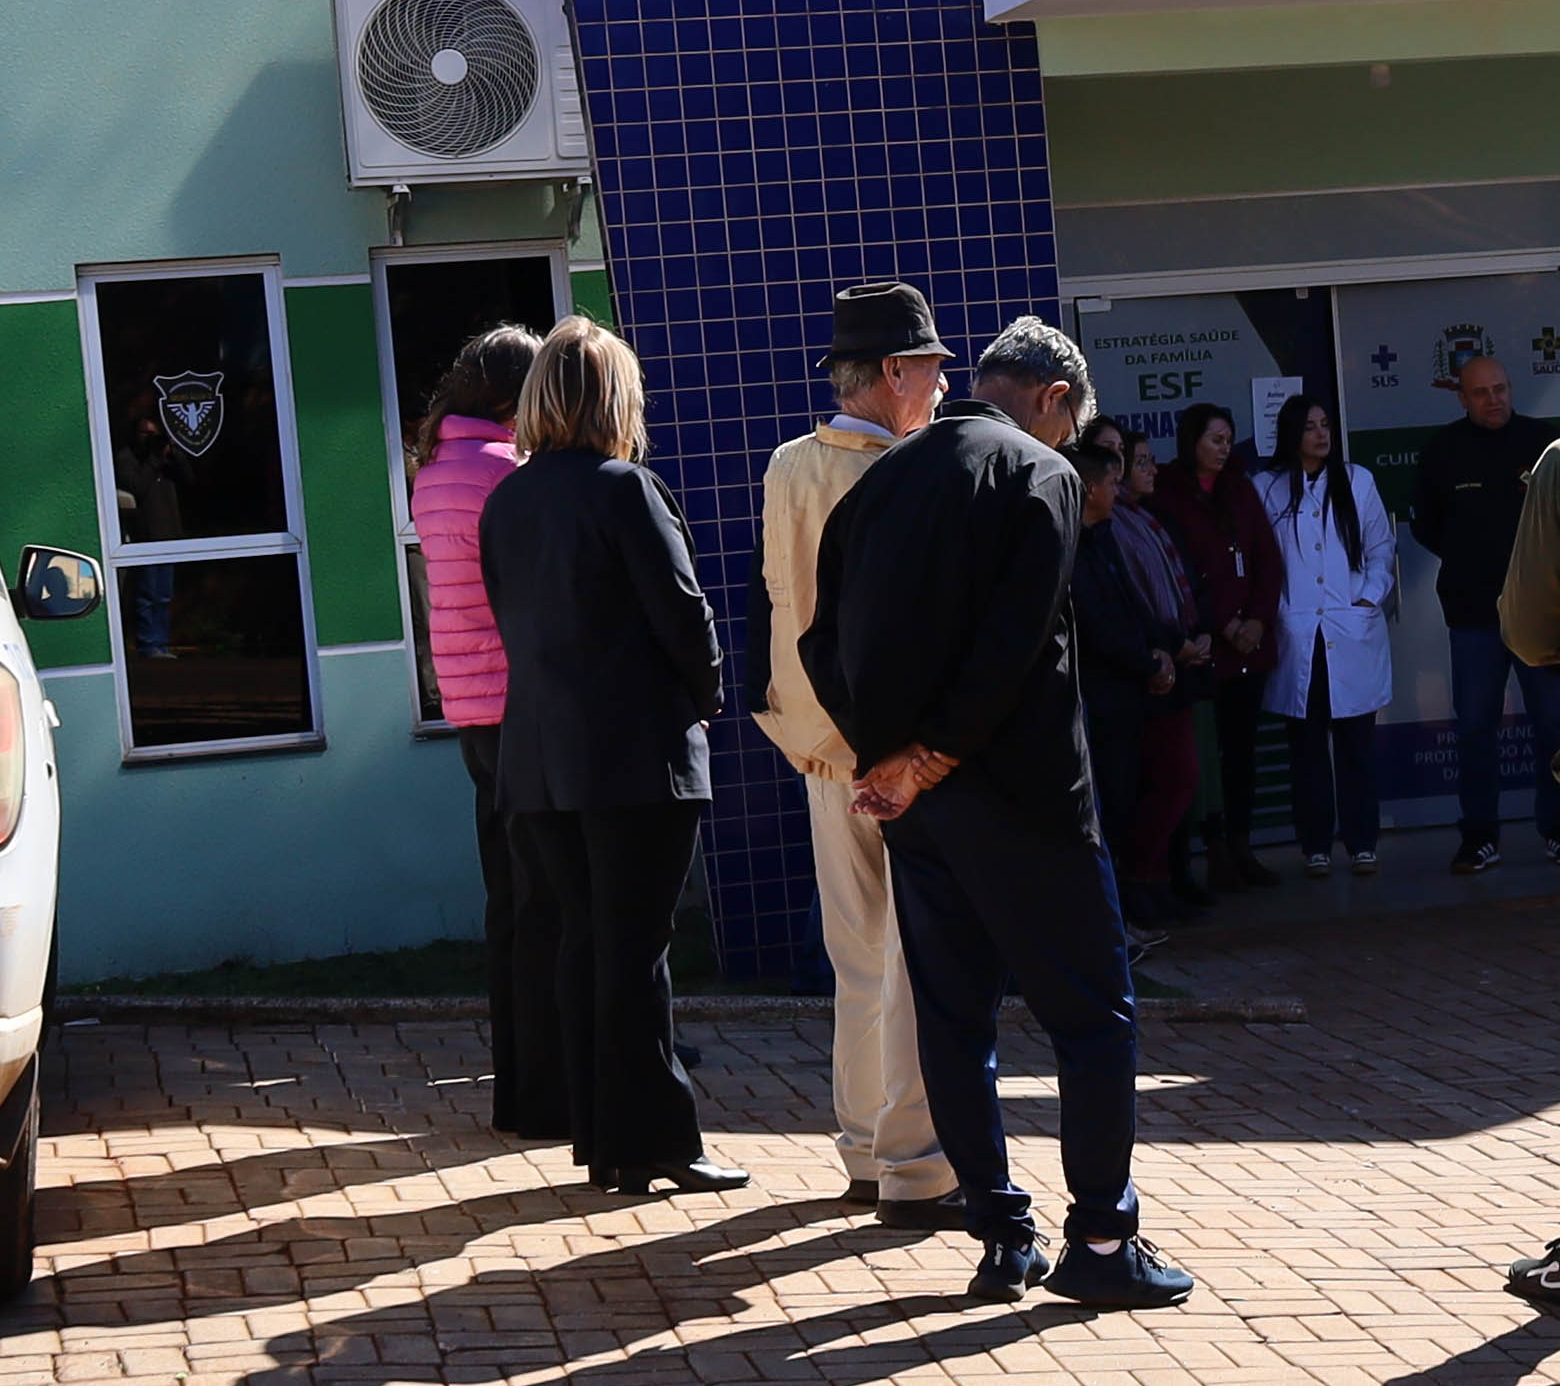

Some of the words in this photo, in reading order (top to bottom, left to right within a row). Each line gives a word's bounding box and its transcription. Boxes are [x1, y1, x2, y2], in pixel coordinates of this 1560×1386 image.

[1094, 332, 1185, 350] ESTRATÉGIA
[1189, 328, 1240, 343] SAÚDE
[1124, 354, 1148, 366] DA
[1150, 349, 1214, 364] FAMÍLIA
[1138, 370, 1203, 402] ESF
[1370, 374, 1400, 388] SUS
